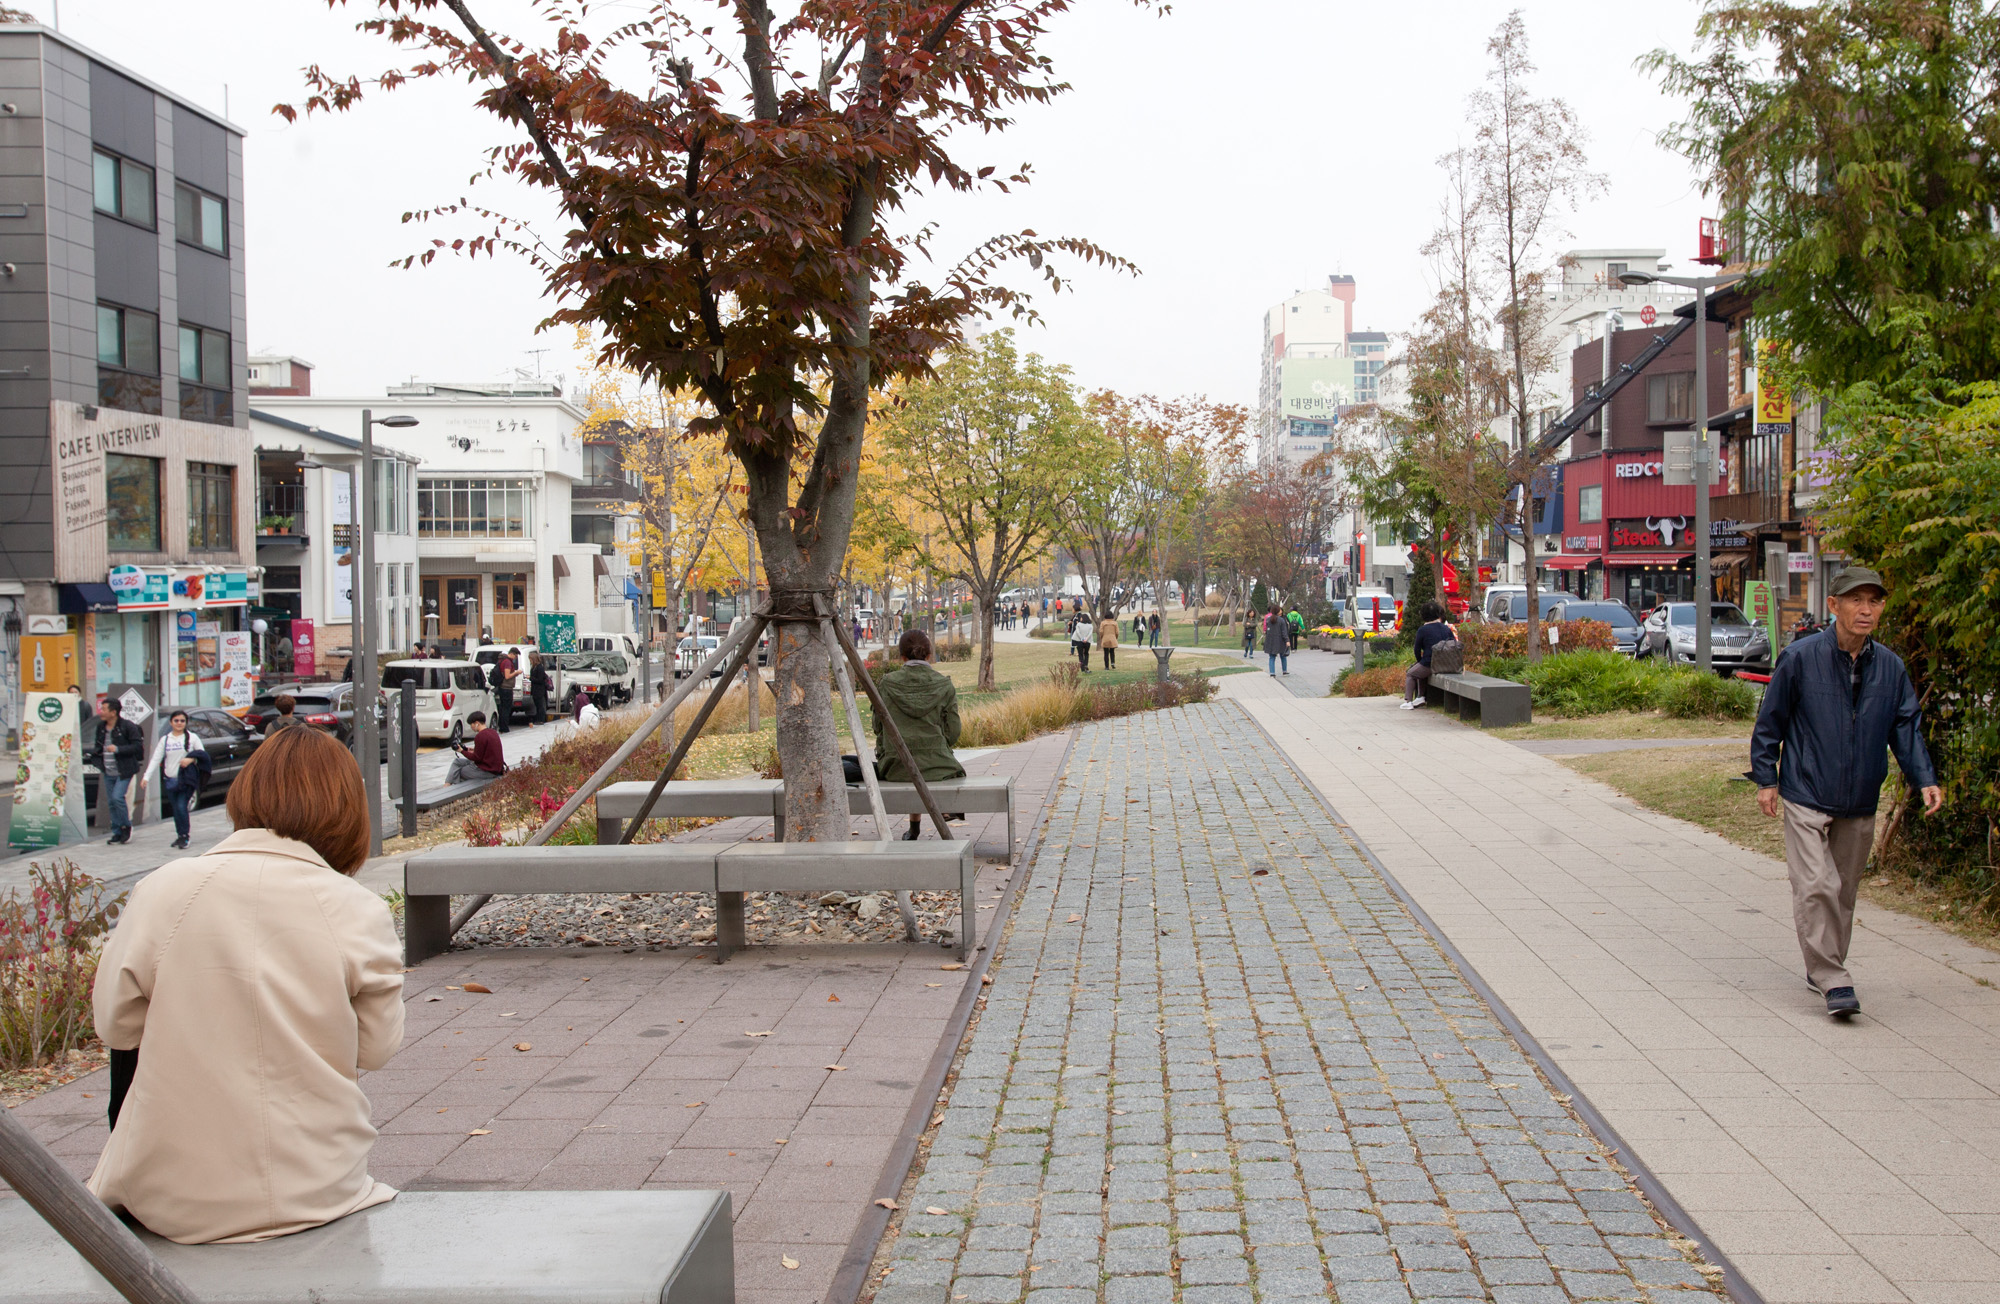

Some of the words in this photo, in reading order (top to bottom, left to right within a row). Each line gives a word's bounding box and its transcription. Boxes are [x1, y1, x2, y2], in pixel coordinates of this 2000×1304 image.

[1757, 424, 1790, 433] 325-5775
[59, 436, 93, 459] CAFE
[96, 422, 161, 451] INTERVIEW
[1613, 528, 1660, 546] Steak
[1795, 561, 1813, 569] 부동산
